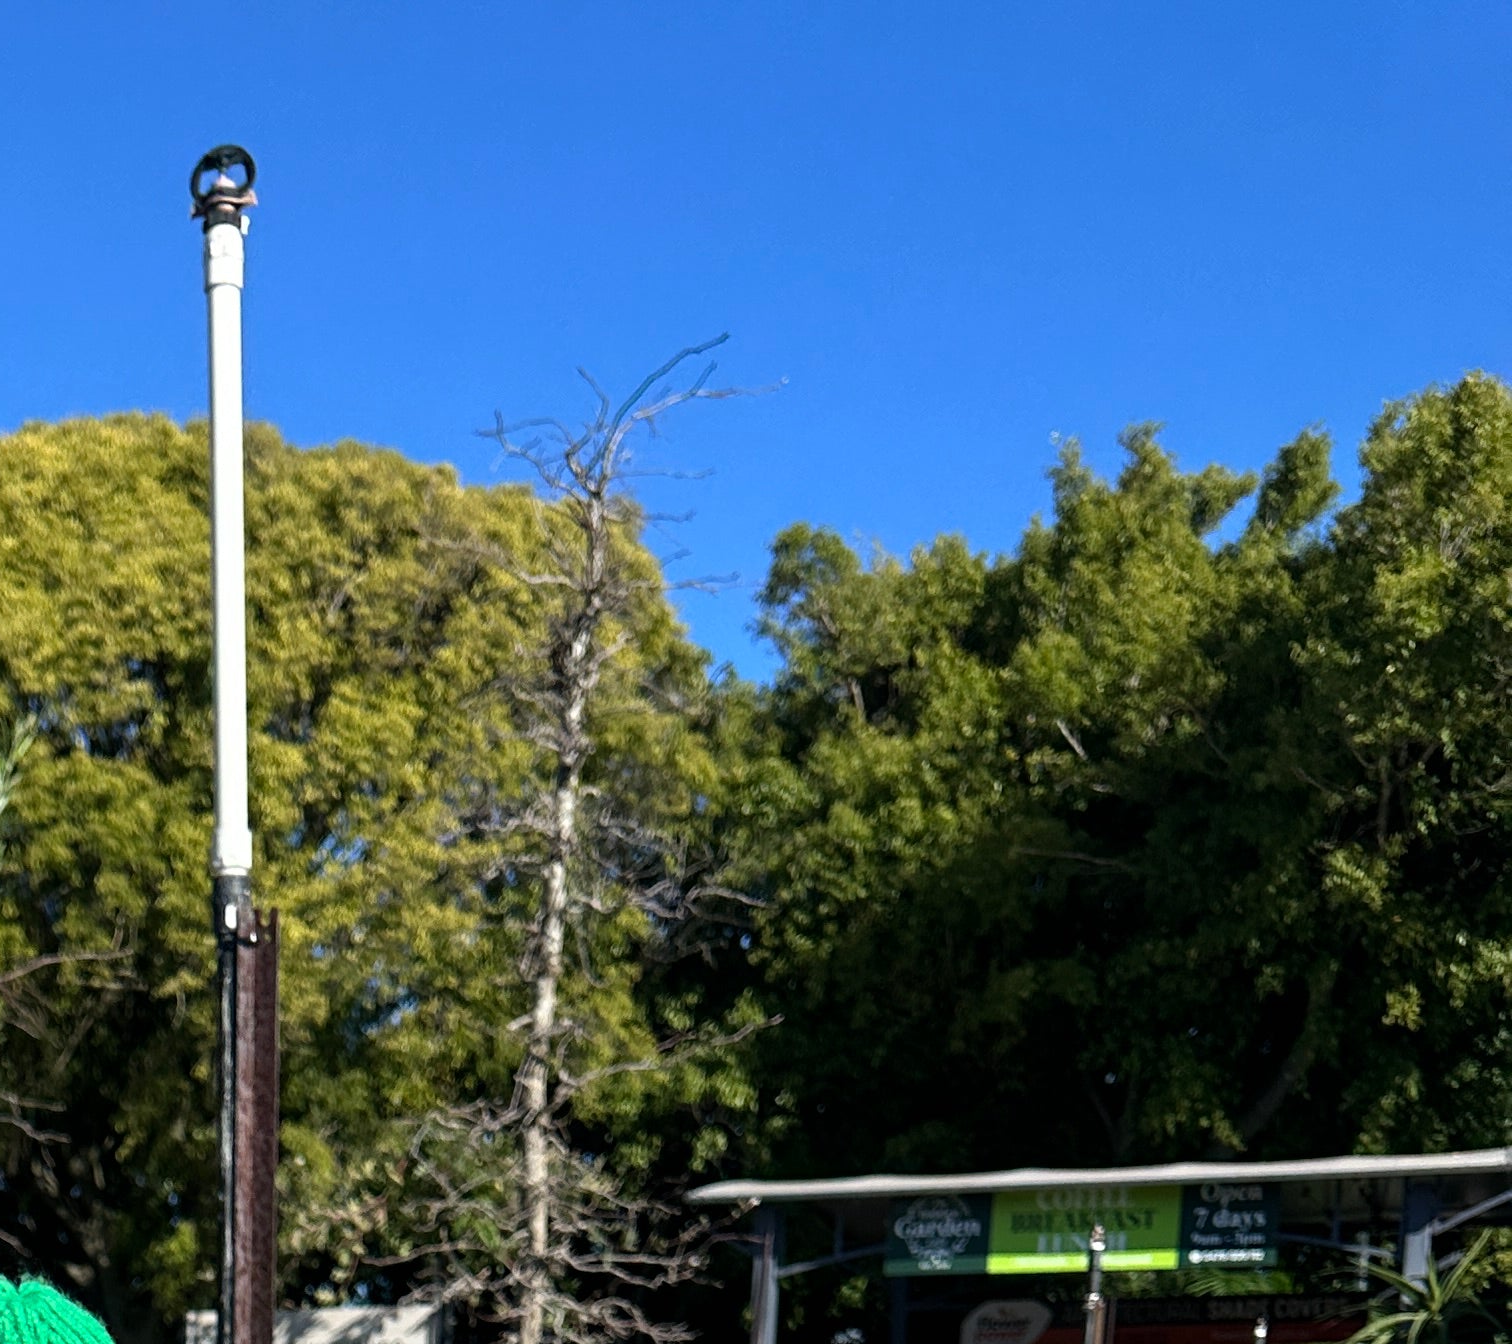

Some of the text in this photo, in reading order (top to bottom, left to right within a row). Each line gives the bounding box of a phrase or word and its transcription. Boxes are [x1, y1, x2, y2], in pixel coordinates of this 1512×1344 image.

[1200, 1184, 1263, 1207] Open
[894, 1215, 981, 1239] Garden
[1011, 1208, 1157, 1233] BREAKFAST
[1193, 1207, 1267, 1233] 7 days
[1038, 1230, 1127, 1252] LUNH
